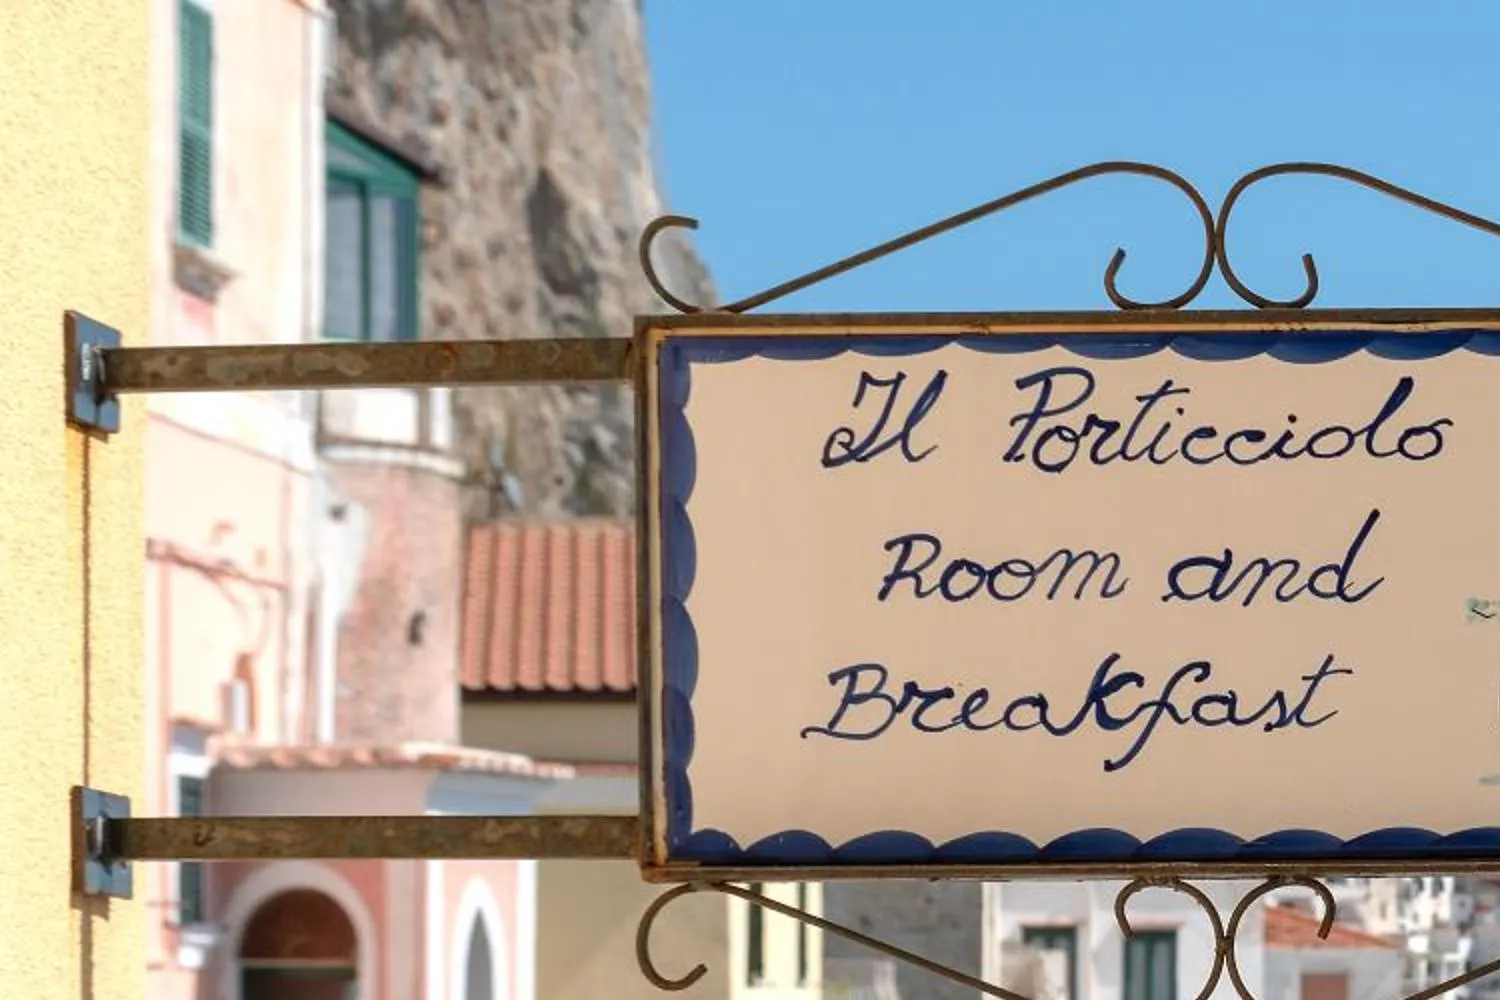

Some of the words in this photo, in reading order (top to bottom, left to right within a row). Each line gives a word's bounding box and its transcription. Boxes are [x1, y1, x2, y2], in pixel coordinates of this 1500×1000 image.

[820, 368, 950, 470] Il
[1002, 366, 1455, 474] Porticciolo
[877, 532, 1129, 604] Room
[1161, 508, 1386, 607] and
[800, 652, 1354, 773] Breakfast
